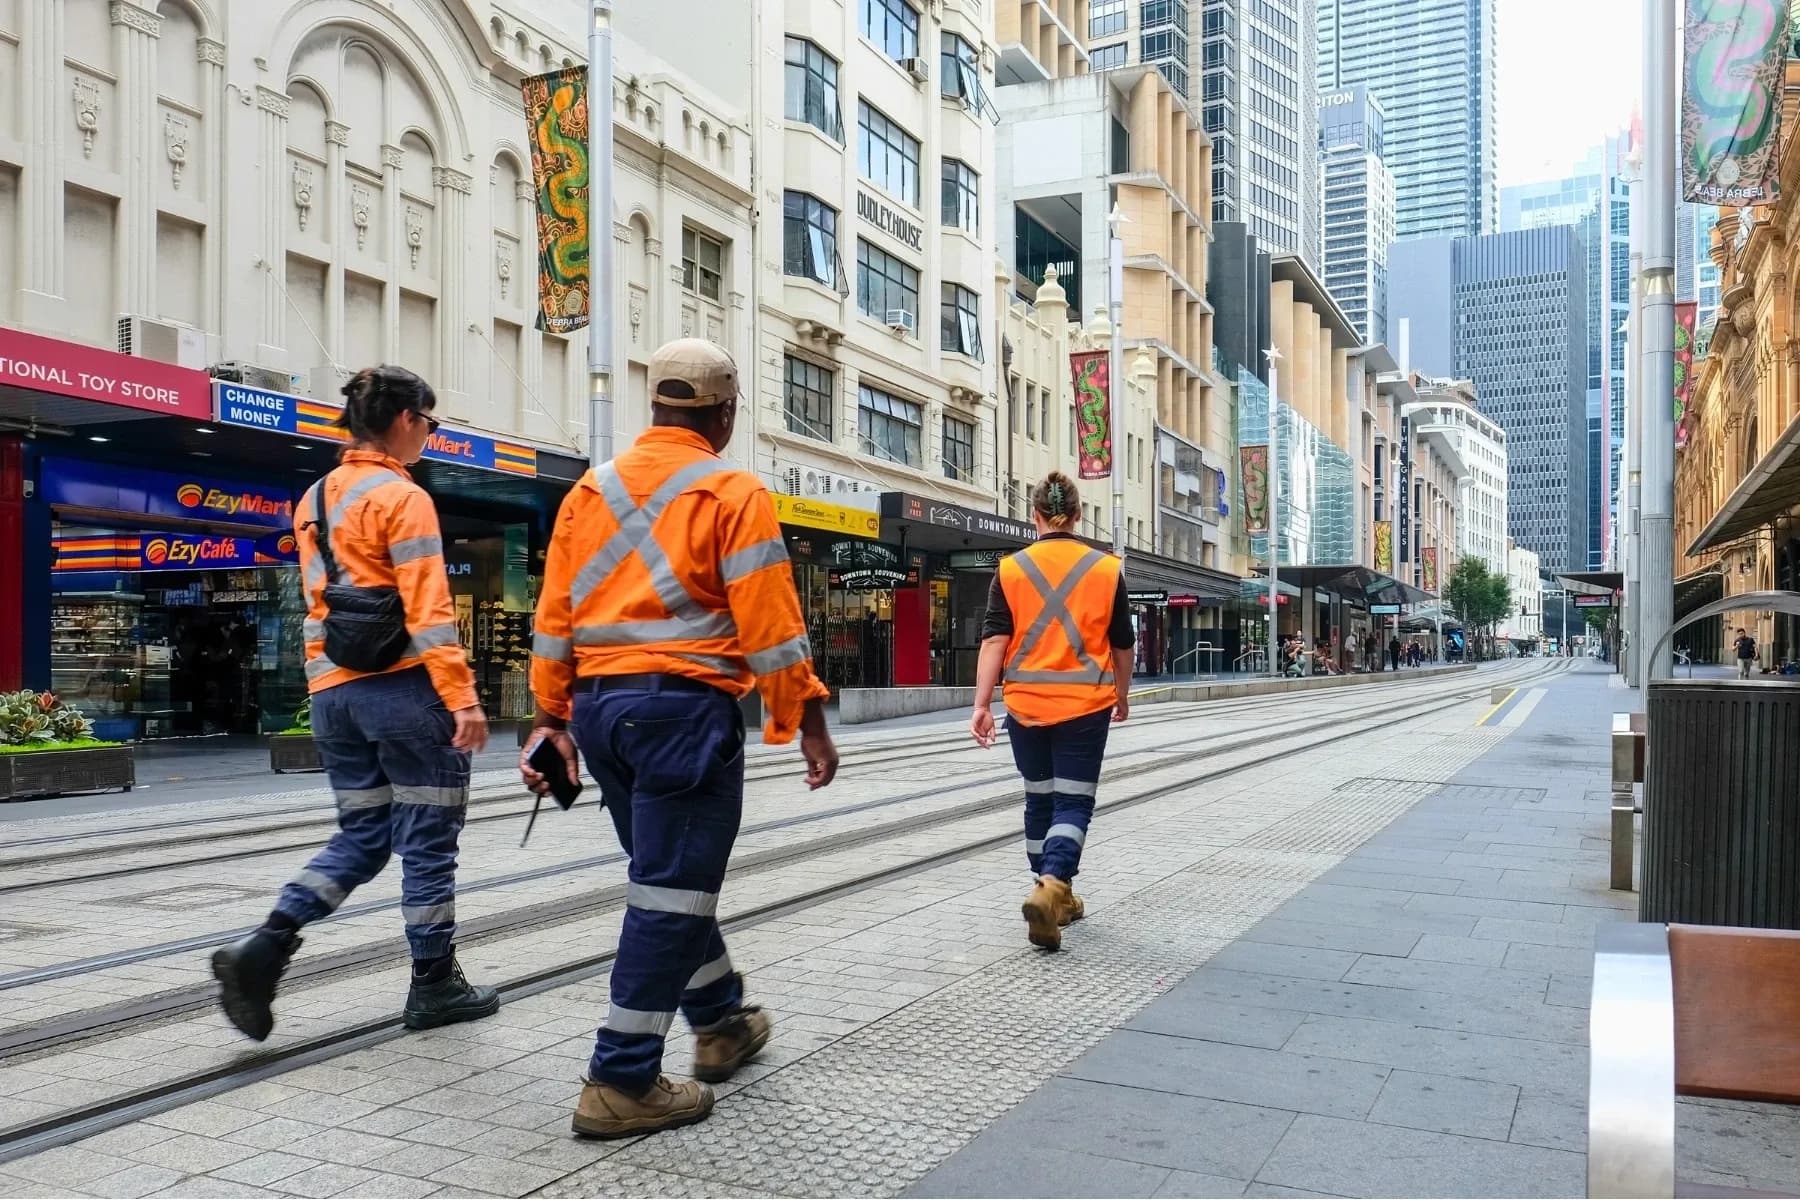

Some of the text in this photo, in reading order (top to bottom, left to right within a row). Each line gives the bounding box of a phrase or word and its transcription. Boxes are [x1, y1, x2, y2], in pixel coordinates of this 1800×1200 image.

[0, 358, 180, 405] TIONAL TOY STORE
[226, 389, 284, 411] CHANGE
[230, 407, 280, 427] MONEY
[427, 433, 472, 457] Mart
[203, 488, 291, 516] EzyMart
[911, 500, 921, 508] TAX
[909, 508, 922, 517] FREE
[978, 518, 1020, 537] DOWNTOWN
[167, 538, 236, 565] EzyCafé
[831, 540, 864, 553] DOWNTWN
[840, 569, 906, 582] DOWNTOWN SOUVENIRS
